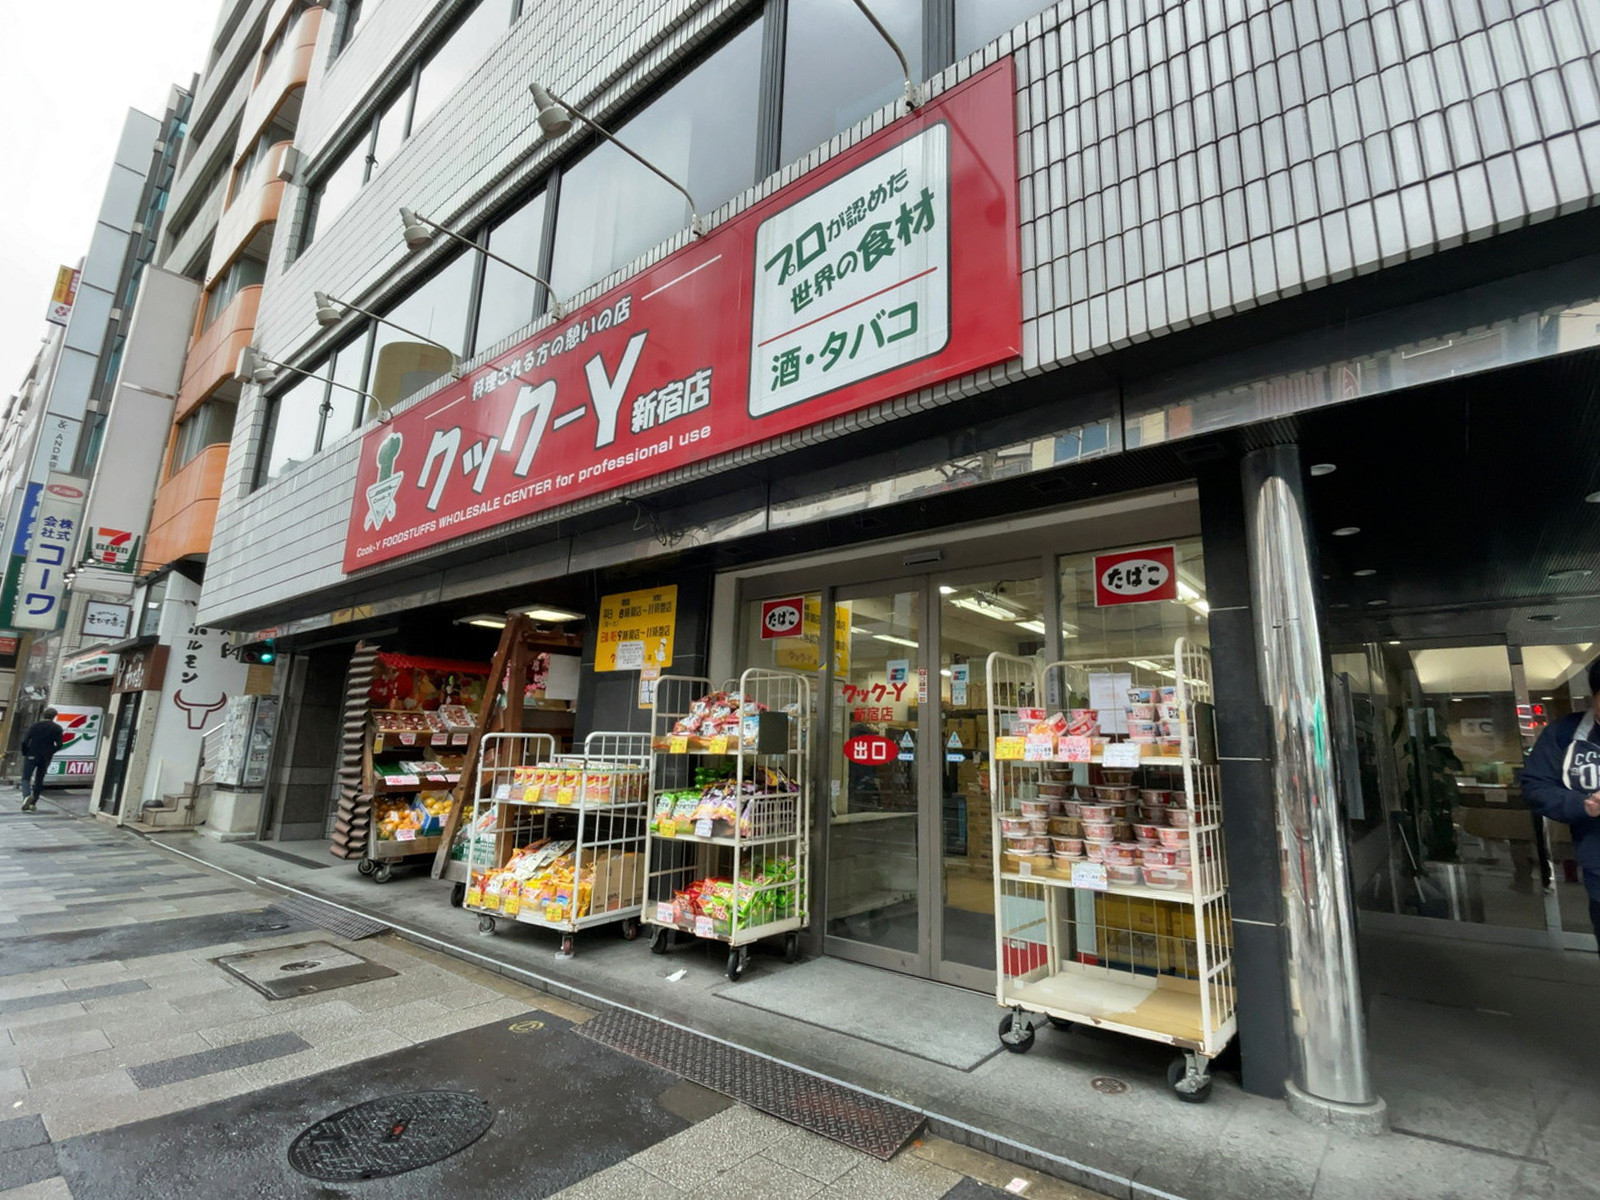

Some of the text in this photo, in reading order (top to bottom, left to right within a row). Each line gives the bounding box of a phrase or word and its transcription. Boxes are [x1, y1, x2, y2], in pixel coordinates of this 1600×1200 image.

[763, 168, 909, 286] プロが認めた
[790, 187, 936, 314] 世界の食材
[472, 295, 632, 401] 料理される方の憩いの店
[771, 301, 919, 391] 酒・タバコ
[631, 368, 713, 435] 新宿店
[356, 424, 712, 558] Cook-Y FOODSTUFFS WHOLESALE CENTER for professional use
[26, 543, 65, 615] コーワ
[1108, 564, 1160, 589] たばこ
[768, 609, 798, 628] たばこ
[853, 706, 894, 722] 新宿店
[68, 761, 95, 774] ATM
[853, 740, 887, 760] 出口
